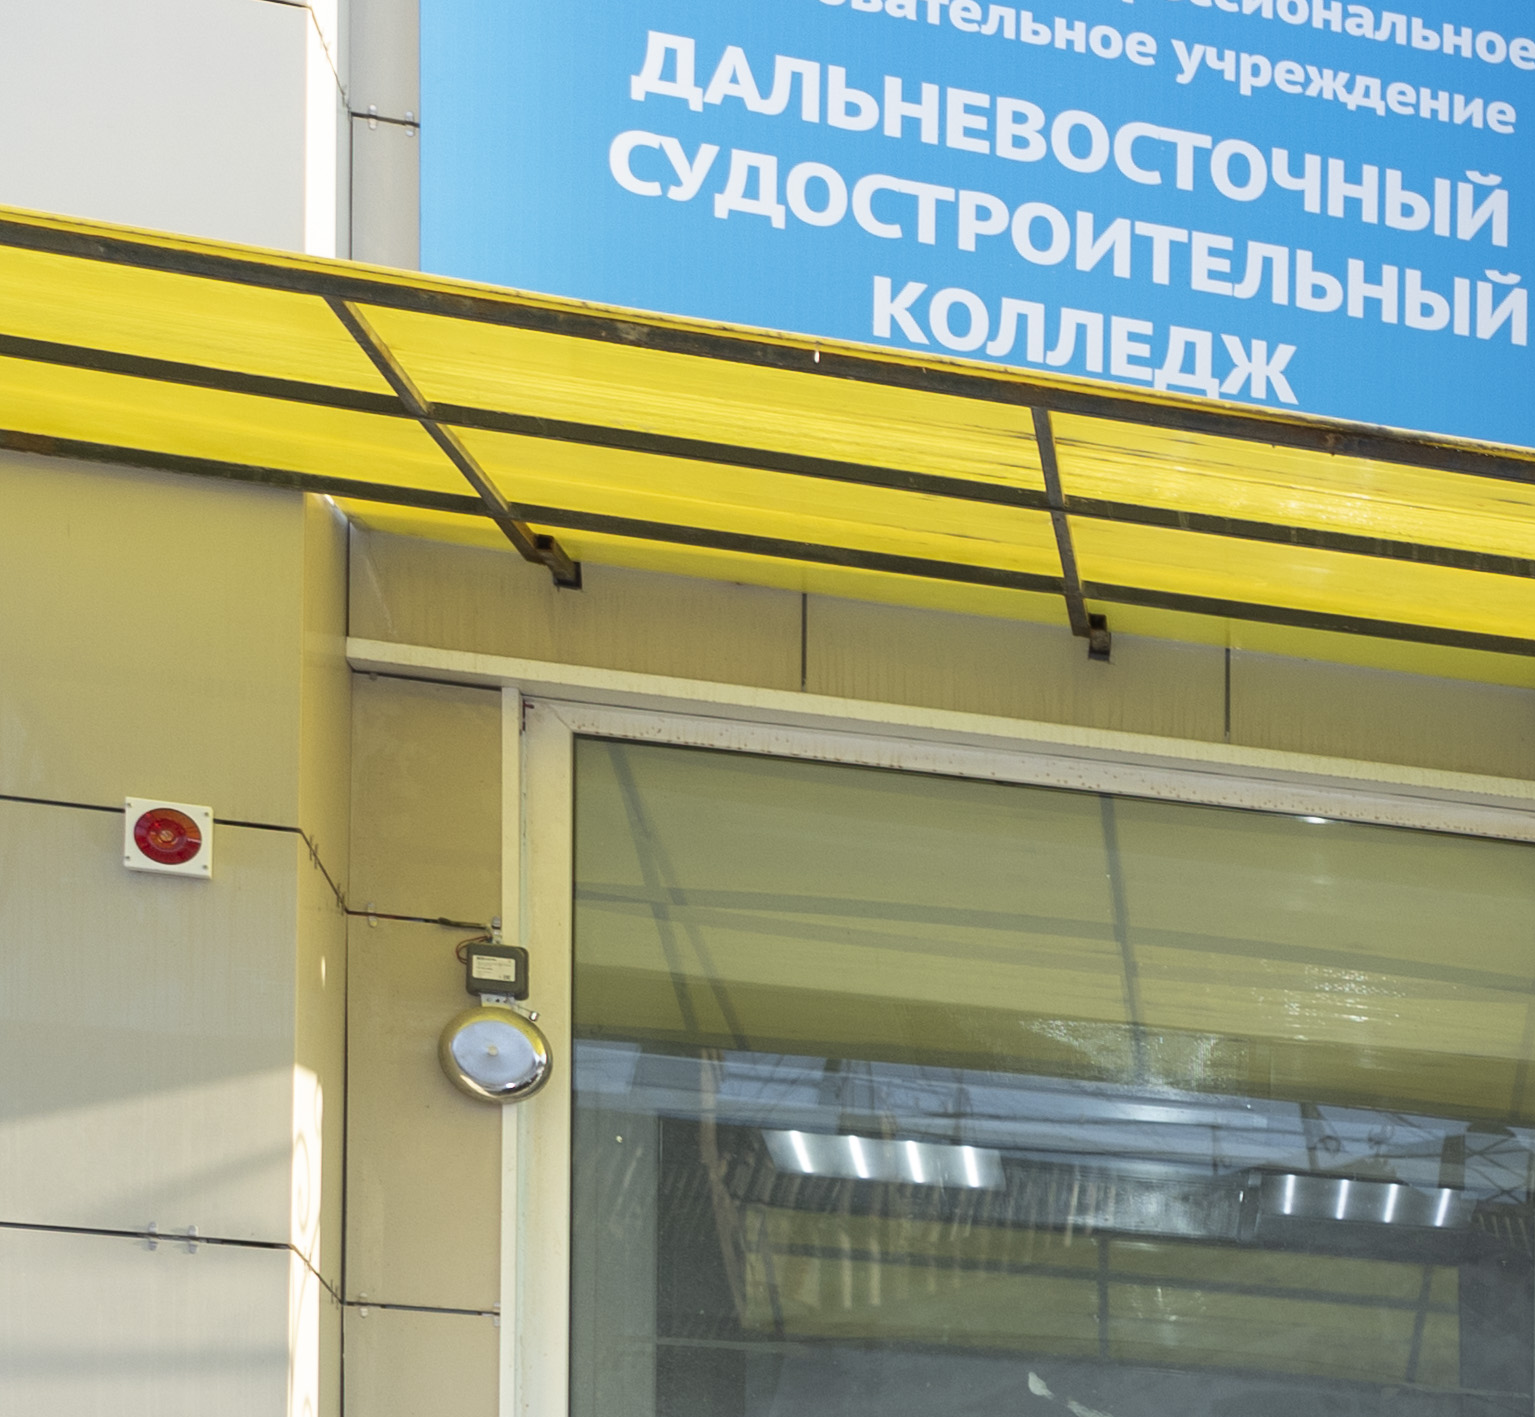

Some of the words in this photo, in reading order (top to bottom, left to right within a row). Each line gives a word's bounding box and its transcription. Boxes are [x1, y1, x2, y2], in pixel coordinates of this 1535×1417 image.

[631, 30, 1509, 247] ДАЛЬНЕВОСТОЧНЫЙ
[818, 0, 1158, 66] ательное
[1171, 38, 1517, 134] учреждение
[608, 130, 1529, 346] СУДОСТРОИТЕЛЬНЫЙ
[871, 275, 1299, 405] КОЛЛЕДЖ
